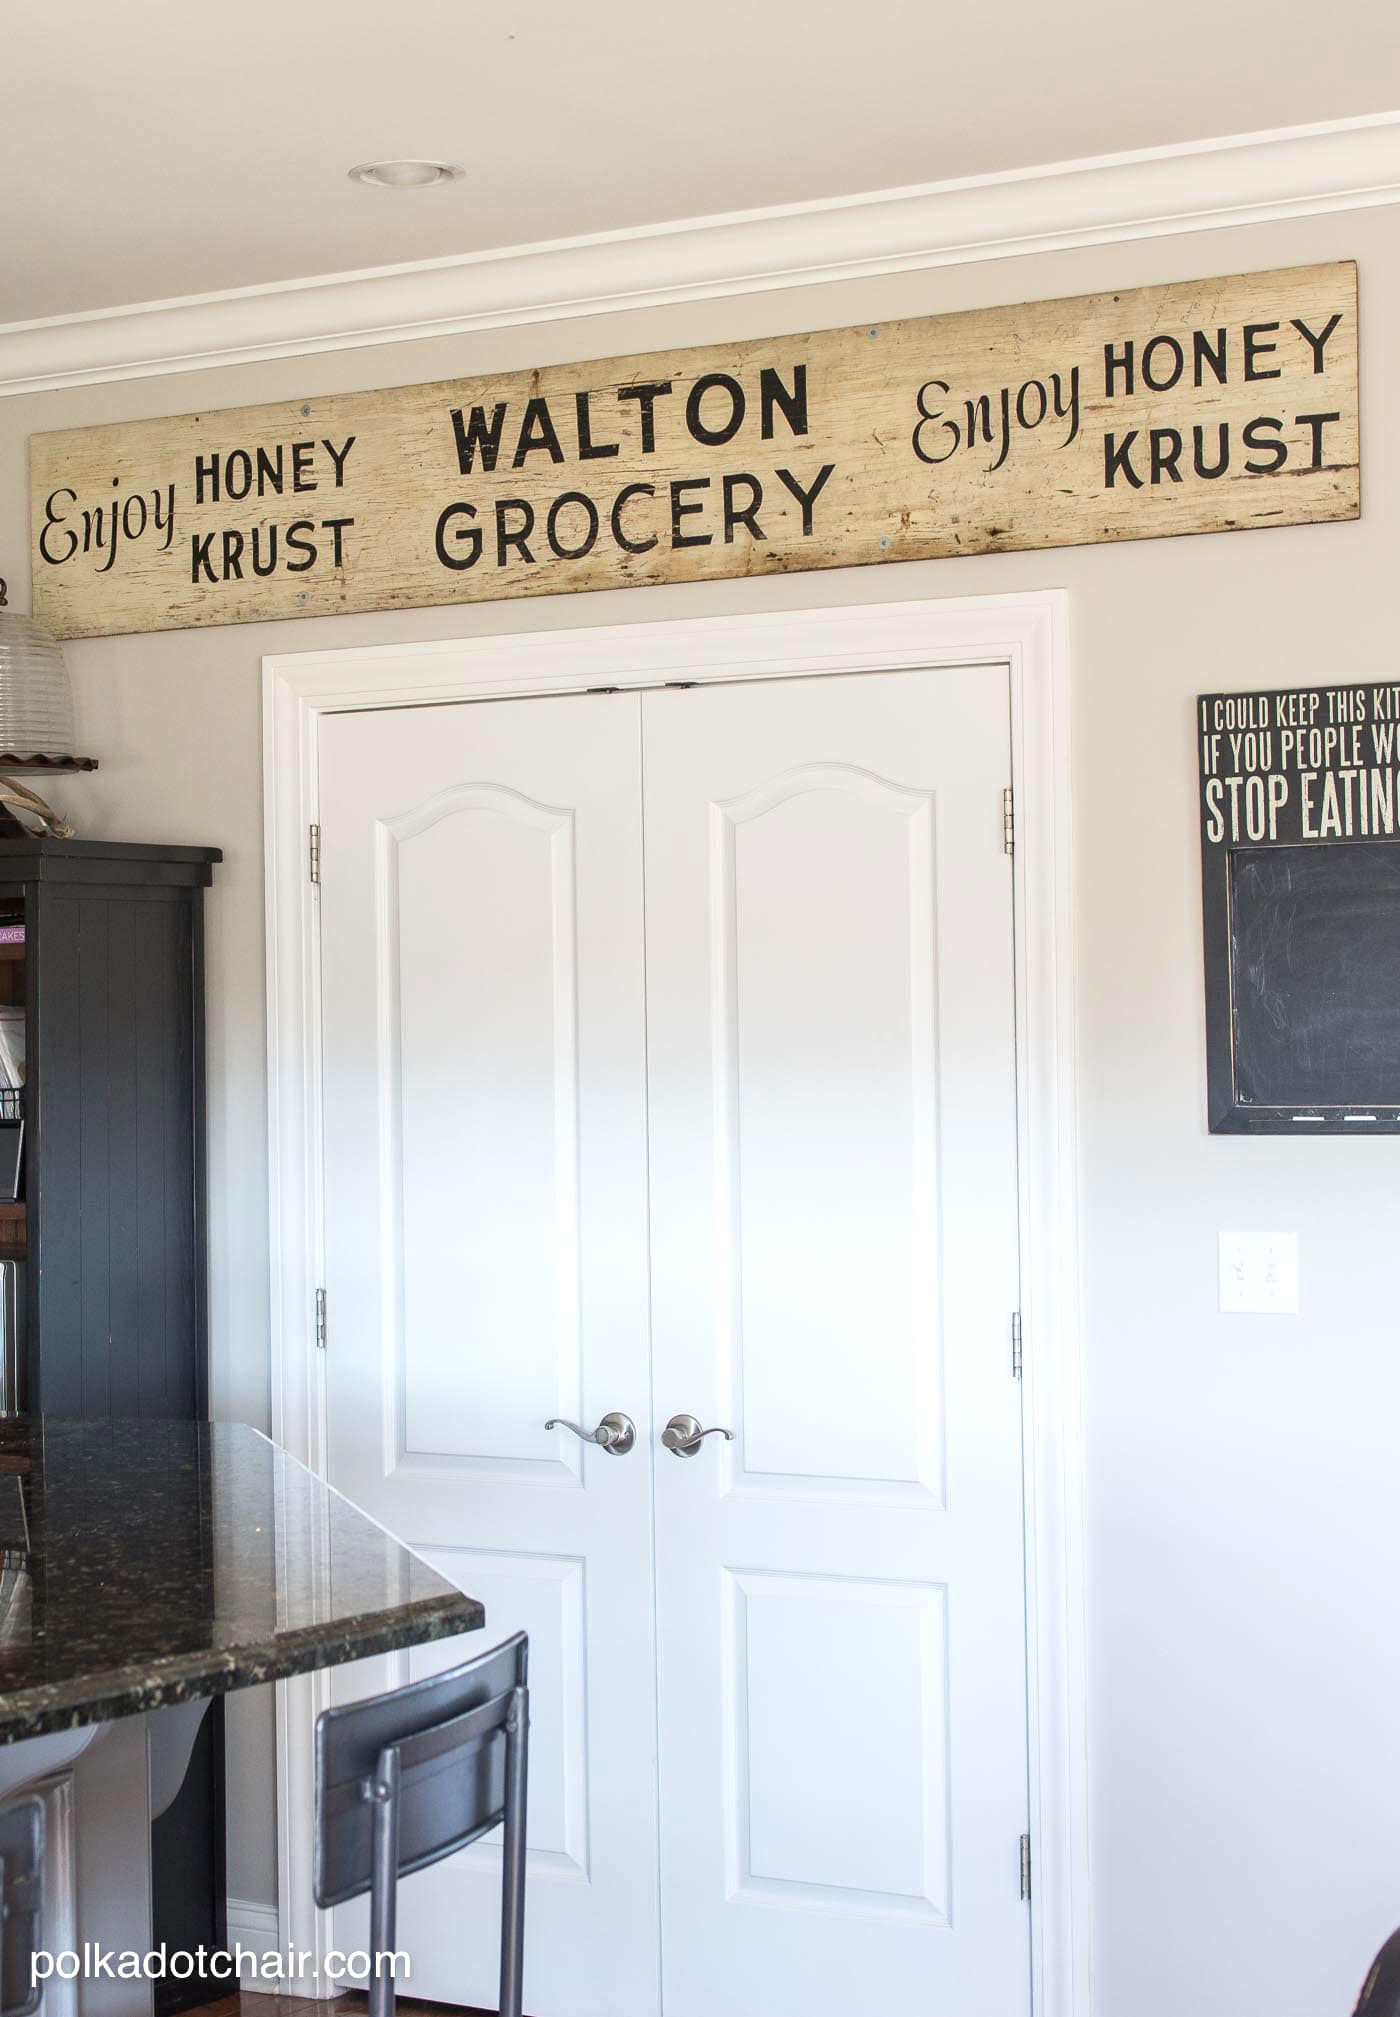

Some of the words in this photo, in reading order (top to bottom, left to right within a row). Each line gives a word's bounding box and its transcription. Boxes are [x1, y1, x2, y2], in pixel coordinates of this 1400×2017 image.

[1103, 314, 1344, 398] HONEY
[450, 364, 808, 475] WALTON
[912, 366, 1079, 473] Enjoy
[1104, 412, 1341, 489] KRUST
[195, 436, 356, 504] HONEY
[39, 477, 175, 573] Enjoy
[191, 517, 354, 584] KRUST
[435, 464, 836, 570] GROCERY
[1202, 700, 1207, 732] I
[1214, 696, 1269, 731] COULD
[1276, 693, 1320, 727] KEEP
[1326, 690, 1366, 724] THIS
[1203, 734, 1221, 775] IF
[1229, 731, 1272, 773] YOU
[1281, 725, 1363, 770] PEOPLE
[1205, 774, 1289, 844] STOP
[1301, 767, 1400, 838] EATIN
